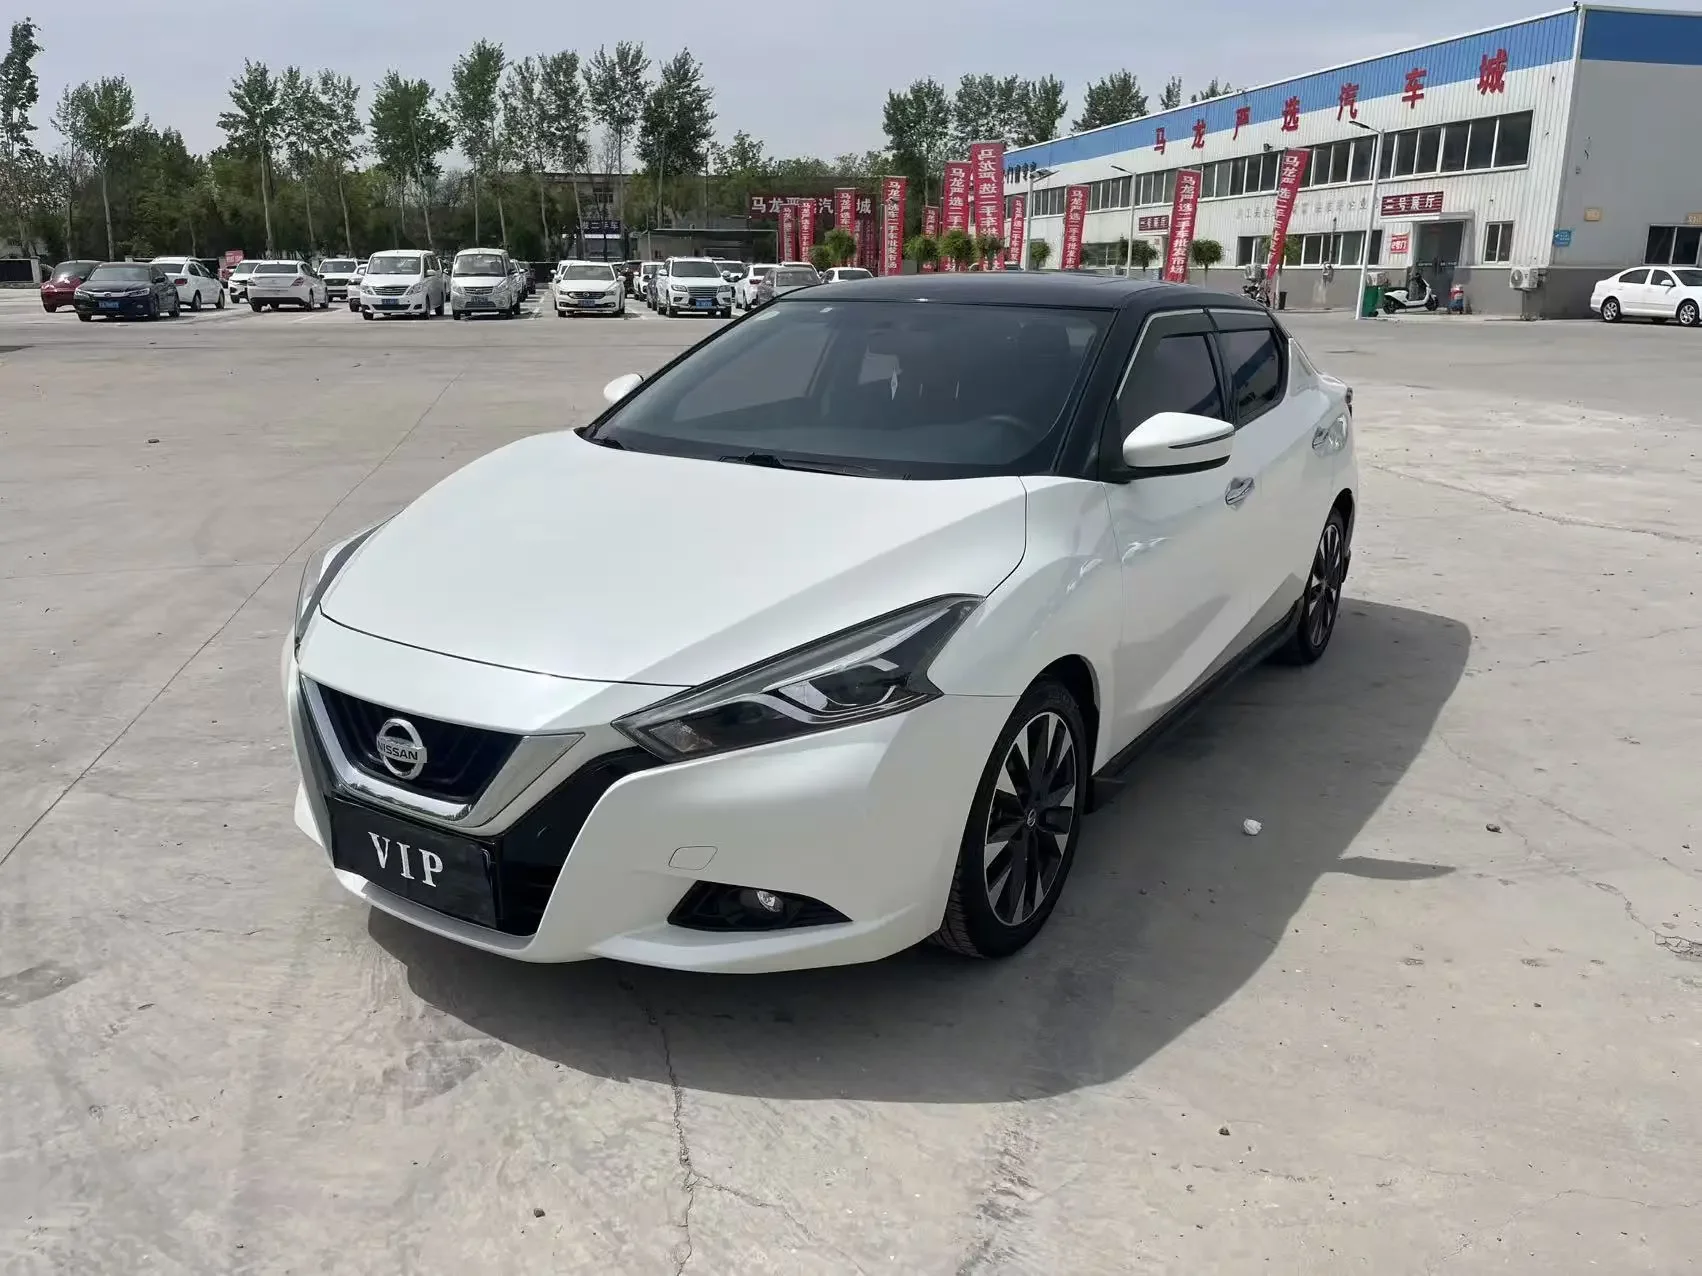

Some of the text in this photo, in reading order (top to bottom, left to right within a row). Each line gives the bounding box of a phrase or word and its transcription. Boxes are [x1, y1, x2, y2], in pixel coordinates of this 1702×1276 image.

[1154, 48, 1509, 155] 马龙严选汽车城
[752, 197, 871, 214] 马龙汽城
[1385, 195, 1435, 211] 二号展厅
[1170, 176, 1196, 274] 马龙严选二手车批发市场
[378, 739, 418, 760] NISSAN
[368, 832, 444, 888] VIP
